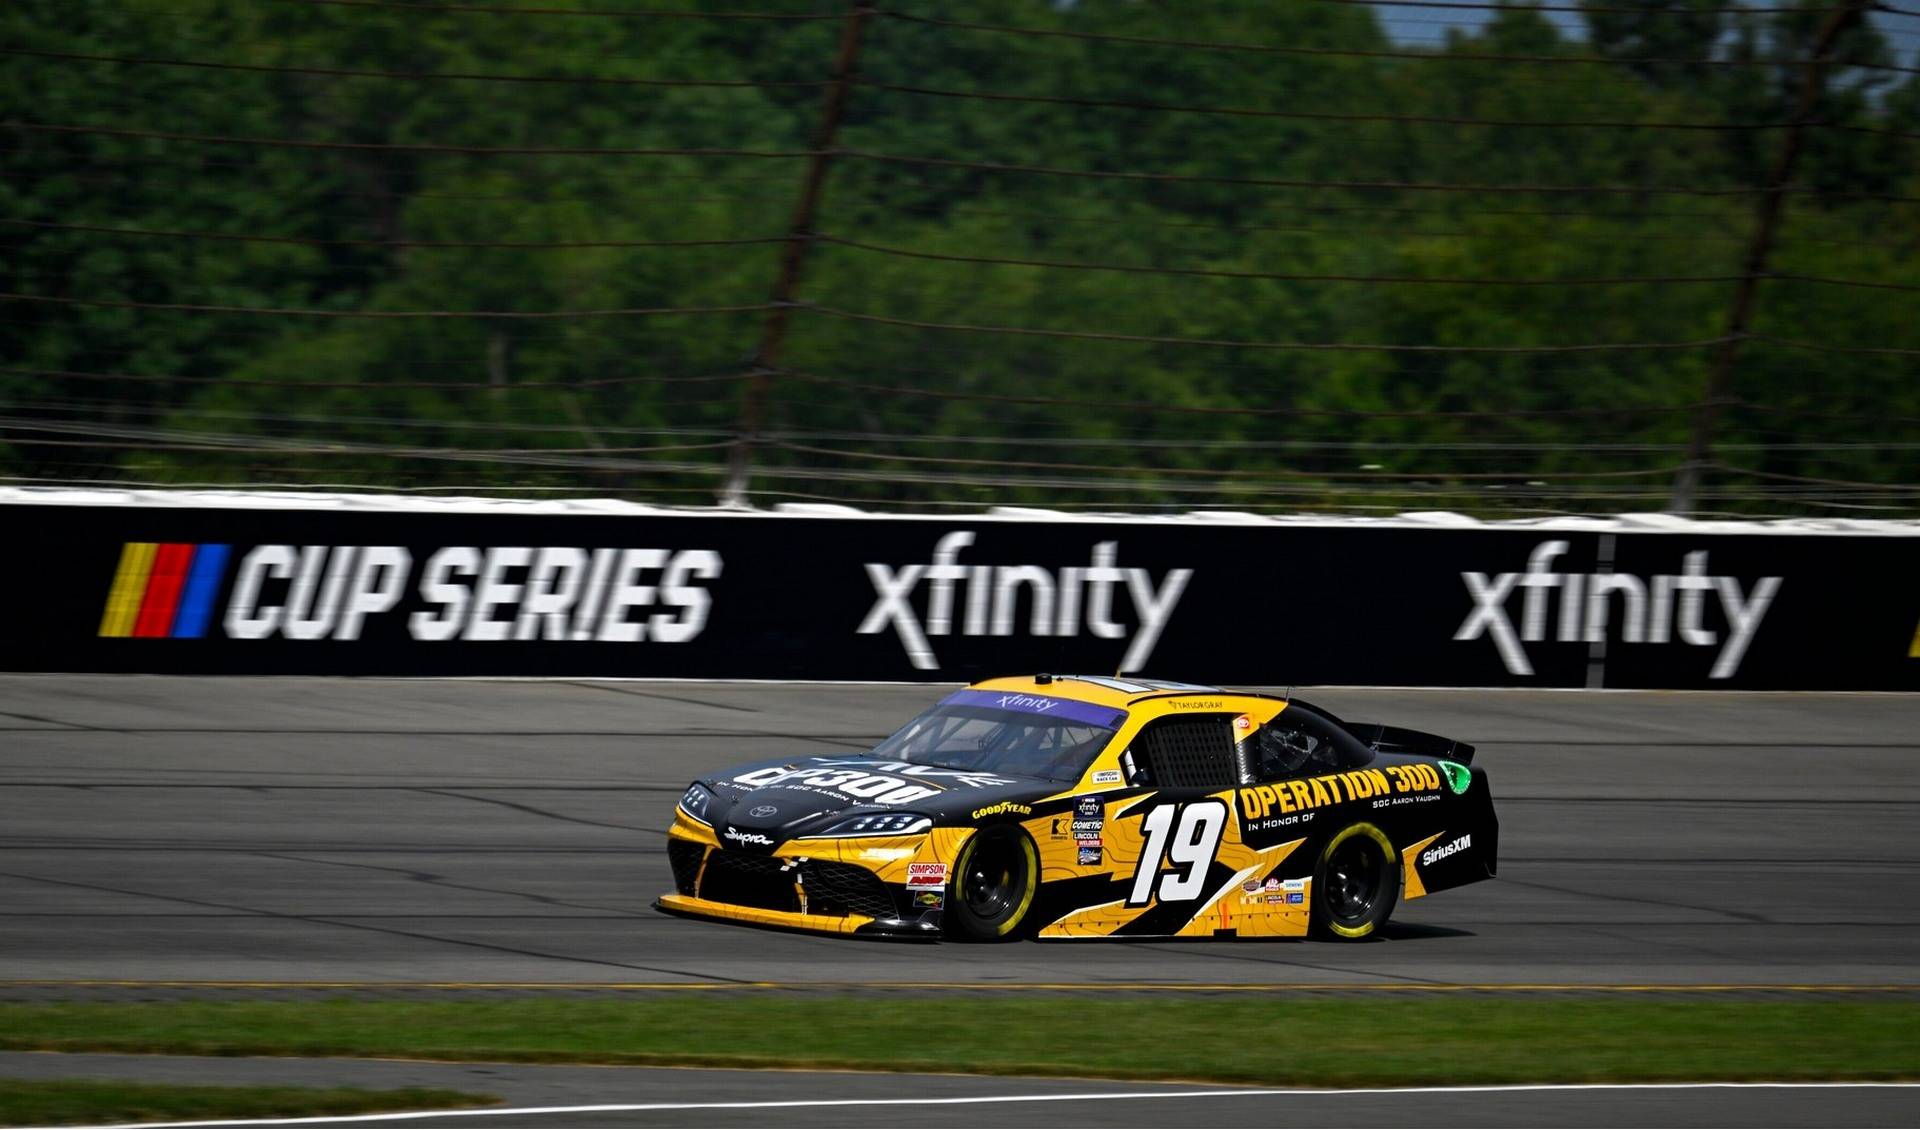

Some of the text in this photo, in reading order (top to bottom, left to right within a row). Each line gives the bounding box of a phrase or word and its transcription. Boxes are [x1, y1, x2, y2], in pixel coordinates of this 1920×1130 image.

[223, 543, 723, 642] CUP SERIES
[855, 531, 1195, 672] xfinity
[1453, 540, 1783, 679] xfinity
[996, 694, 1058, 712] xfinity
[1240, 768, 1391, 820] OPERATION
[1392, 797, 1414, 806] AARON
[1415, 795, 1441, 803] VAUGHN
[971, 801, 1032, 819] GOODYEAR
[1072, 821, 1103, 829] COMETIC
[1248, 812, 1315, 832] IN HONOR OF
[724, 827, 774, 848] Supra
[1129, 802, 1226, 903] 19
[1423, 834, 1471, 866] SiriusXM
[910, 865, 945, 874] SIMPSON
